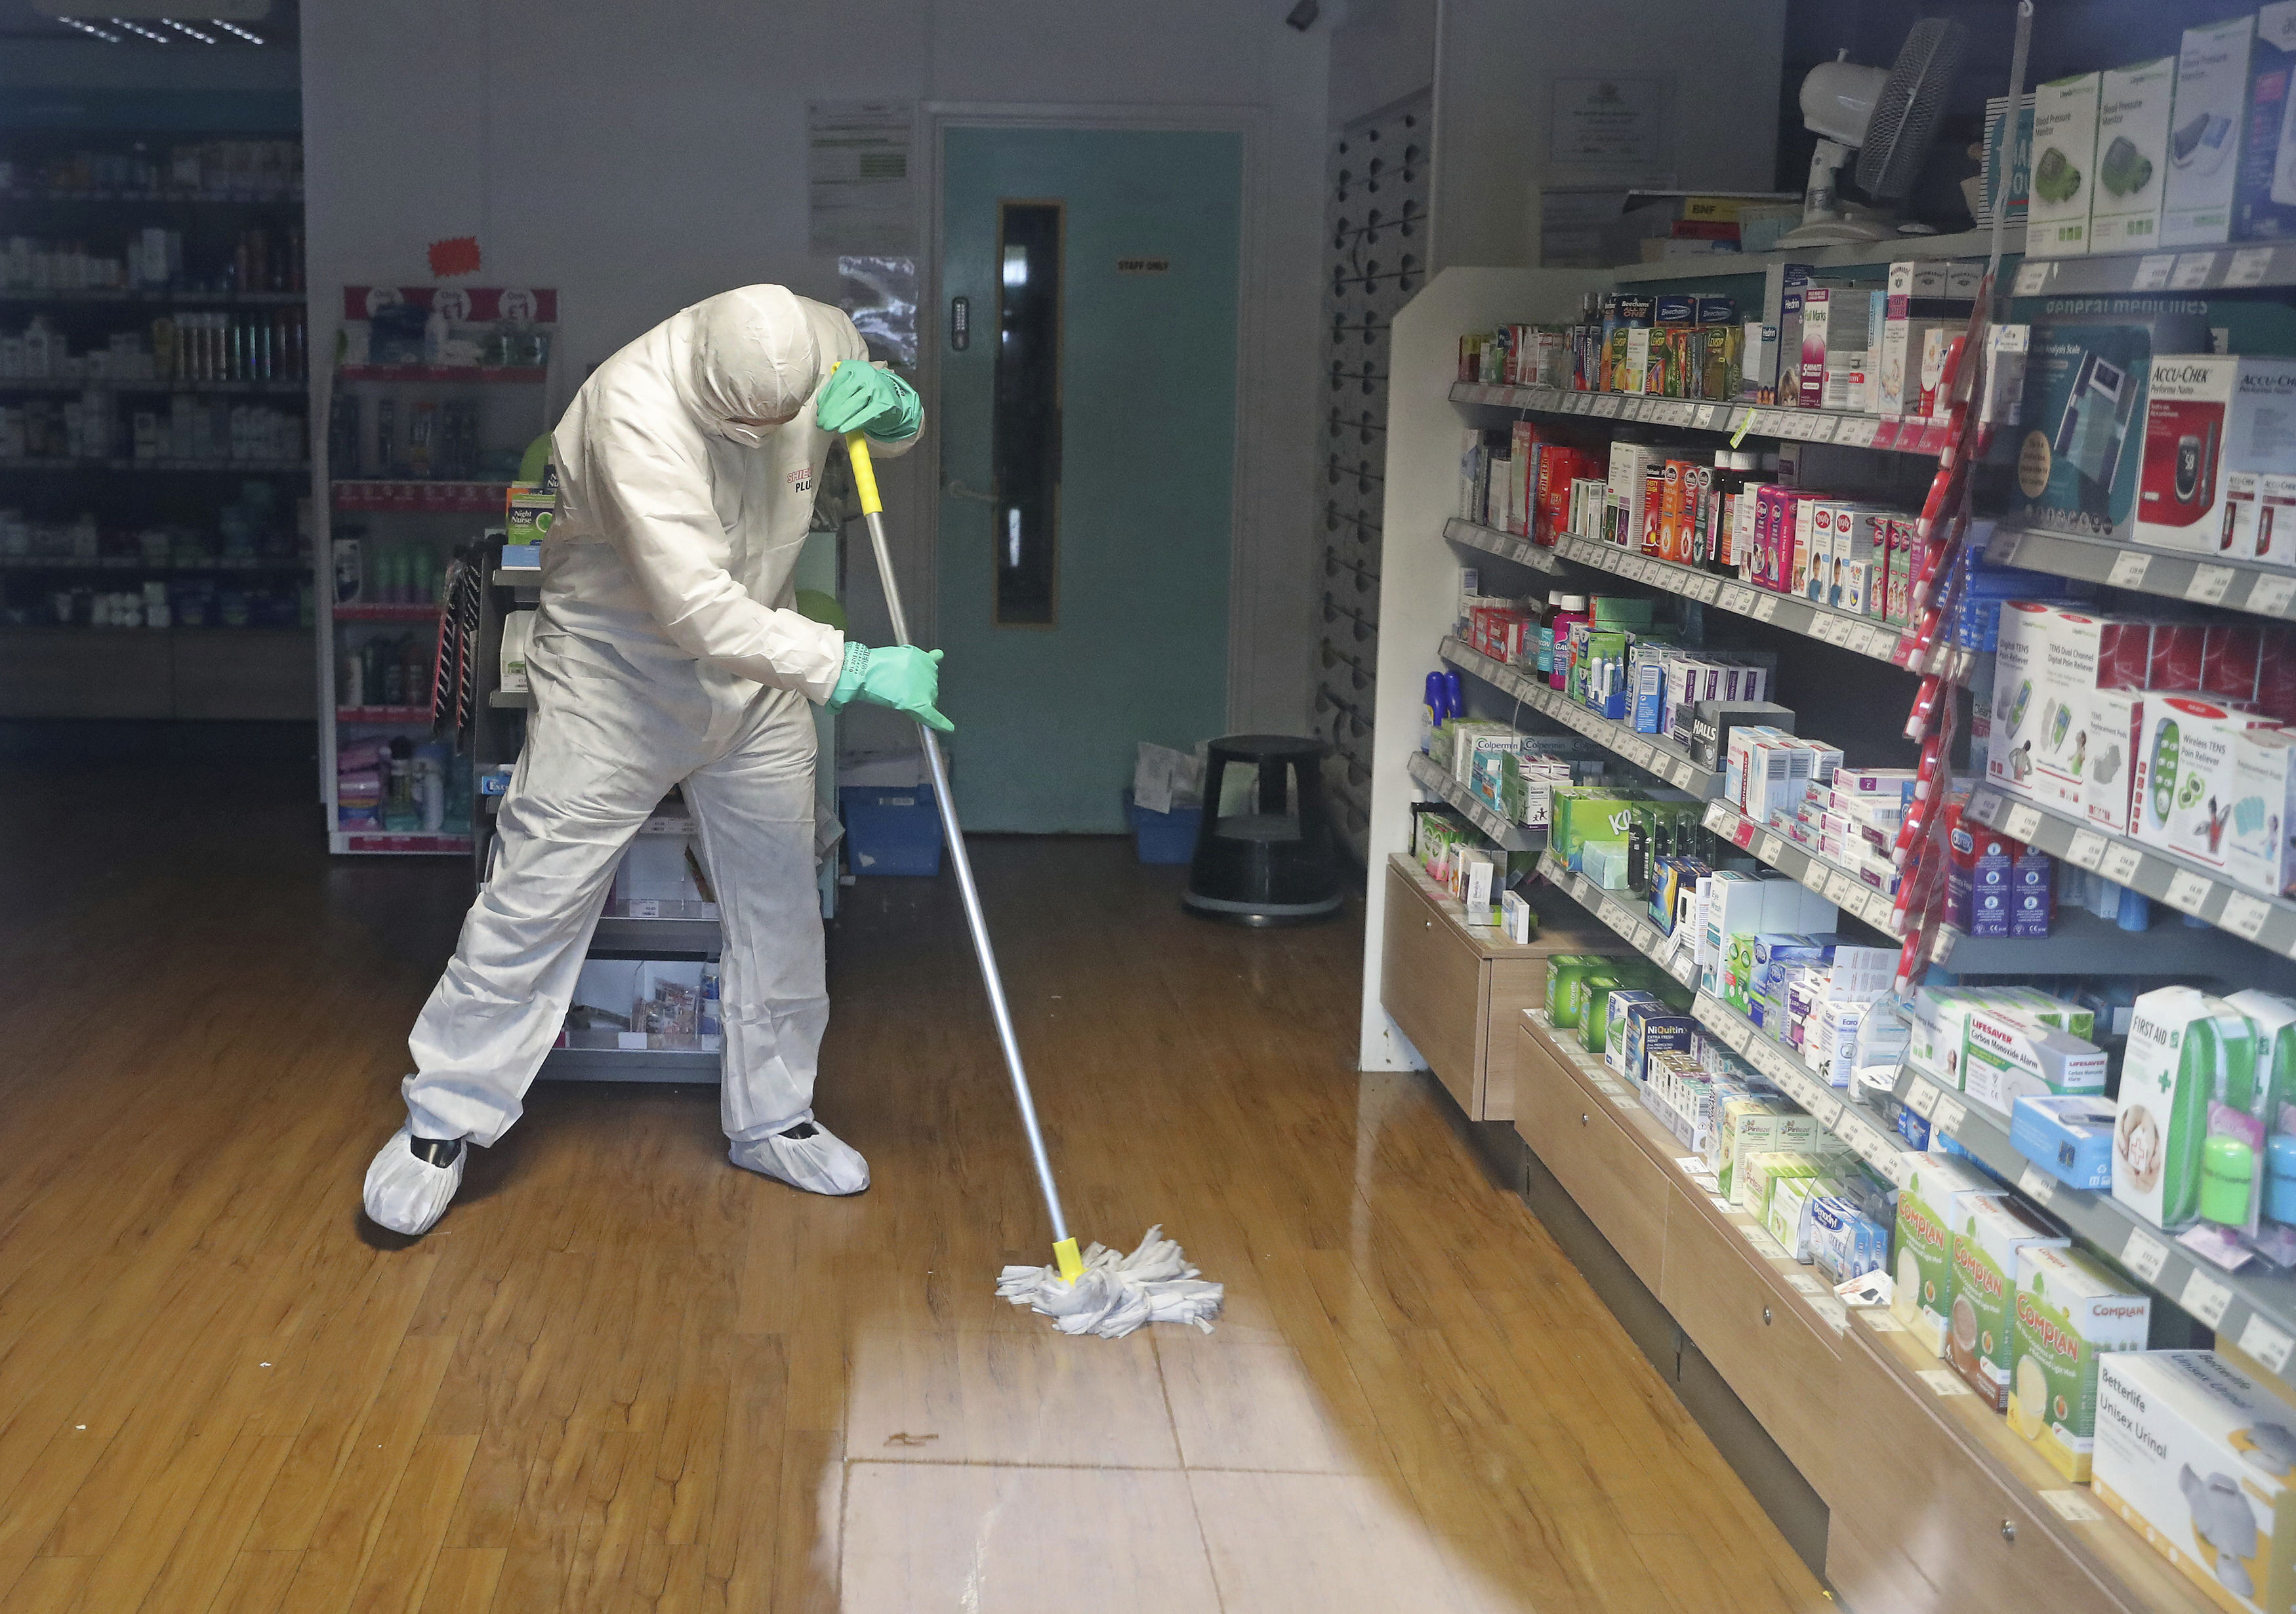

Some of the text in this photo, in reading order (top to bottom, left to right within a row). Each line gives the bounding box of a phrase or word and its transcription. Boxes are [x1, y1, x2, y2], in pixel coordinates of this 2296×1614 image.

[2118, 100, 2142, 111] Pressure
[2050, 113, 2071, 123] Pressure
[2102, 114, 2123, 125] Monitor
[2035, 127, 2053, 136] Monitor
[1692, 204, 1716, 214] BNF
[1118, 261, 1168, 270] STAFF ONLY
[1785, 299, 1799, 310] Hedrin
[1813, 310, 1826, 321] Marks
[1763, 328, 1776, 338] Hedrin
[1708, 338, 1724, 348] LEMSIP
[2178, 385, 2194, 394] Nano
[2015, 643, 2029, 653] TENS
[2049, 643, 2095, 662] TENS Dual Channel
[2048, 655, 2093, 673] Digital Pain Reliever
[1692, 719, 1717, 742] HALLS
[2183, 734, 2226, 754] Wireless TENS
[2181, 748, 2220, 766] Pain Reliever
[1711, 902, 1722, 913] Wash
[1647, 1026, 1684, 1035] NiQuitin
[1972, 1019, 2013, 1045] LIFESAVER
[2132, 1015, 2167, 1045] FIRST AID
[1971, 1029, 1990, 1045] Carbon
[1991, 1039, 2019, 1060] Monoxide
[2019, 1054, 2038, 1070] Alarm
[1814, 1202, 1837, 1229] Benadryl
[2102, 1367, 2146, 1413] Betterlife
[2101, 1393, 2167, 1460] Unisex Urinal
